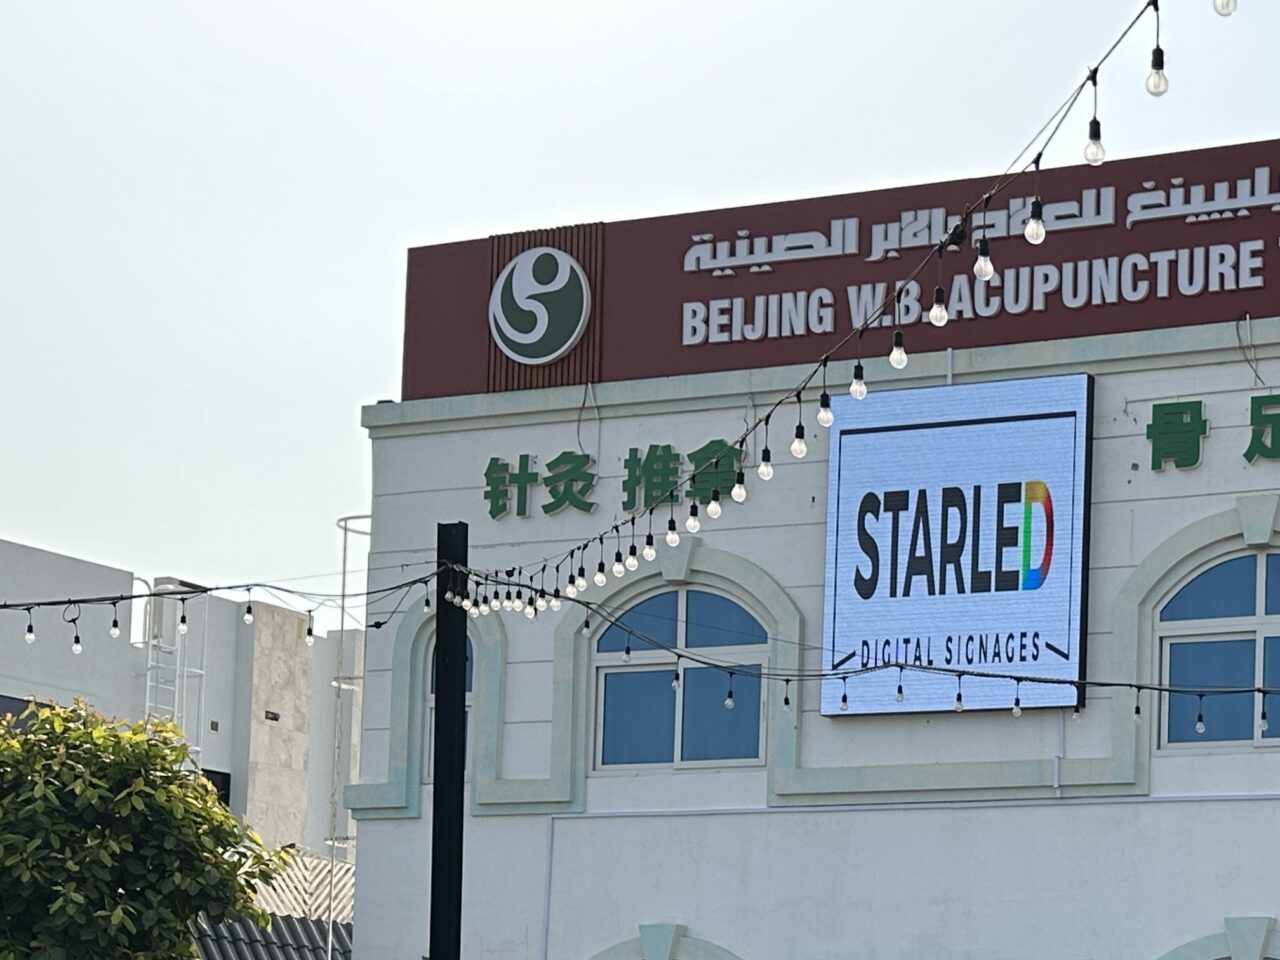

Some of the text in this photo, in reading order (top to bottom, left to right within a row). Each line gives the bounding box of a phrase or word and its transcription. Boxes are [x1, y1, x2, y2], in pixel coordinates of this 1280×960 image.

[683, 217, 860, 277] الصينية
[682, 287, 834, 346] BEIJING
[847, 279, 932, 329] W.B.
[947, 239, 1265, 321] ACUPUNCTURE
[484, 450, 598, 520] 针灸
[854, 480, 1055, 601] STARLED
[861, 631, 1040, 668] DIGITAL SIGNAGES
